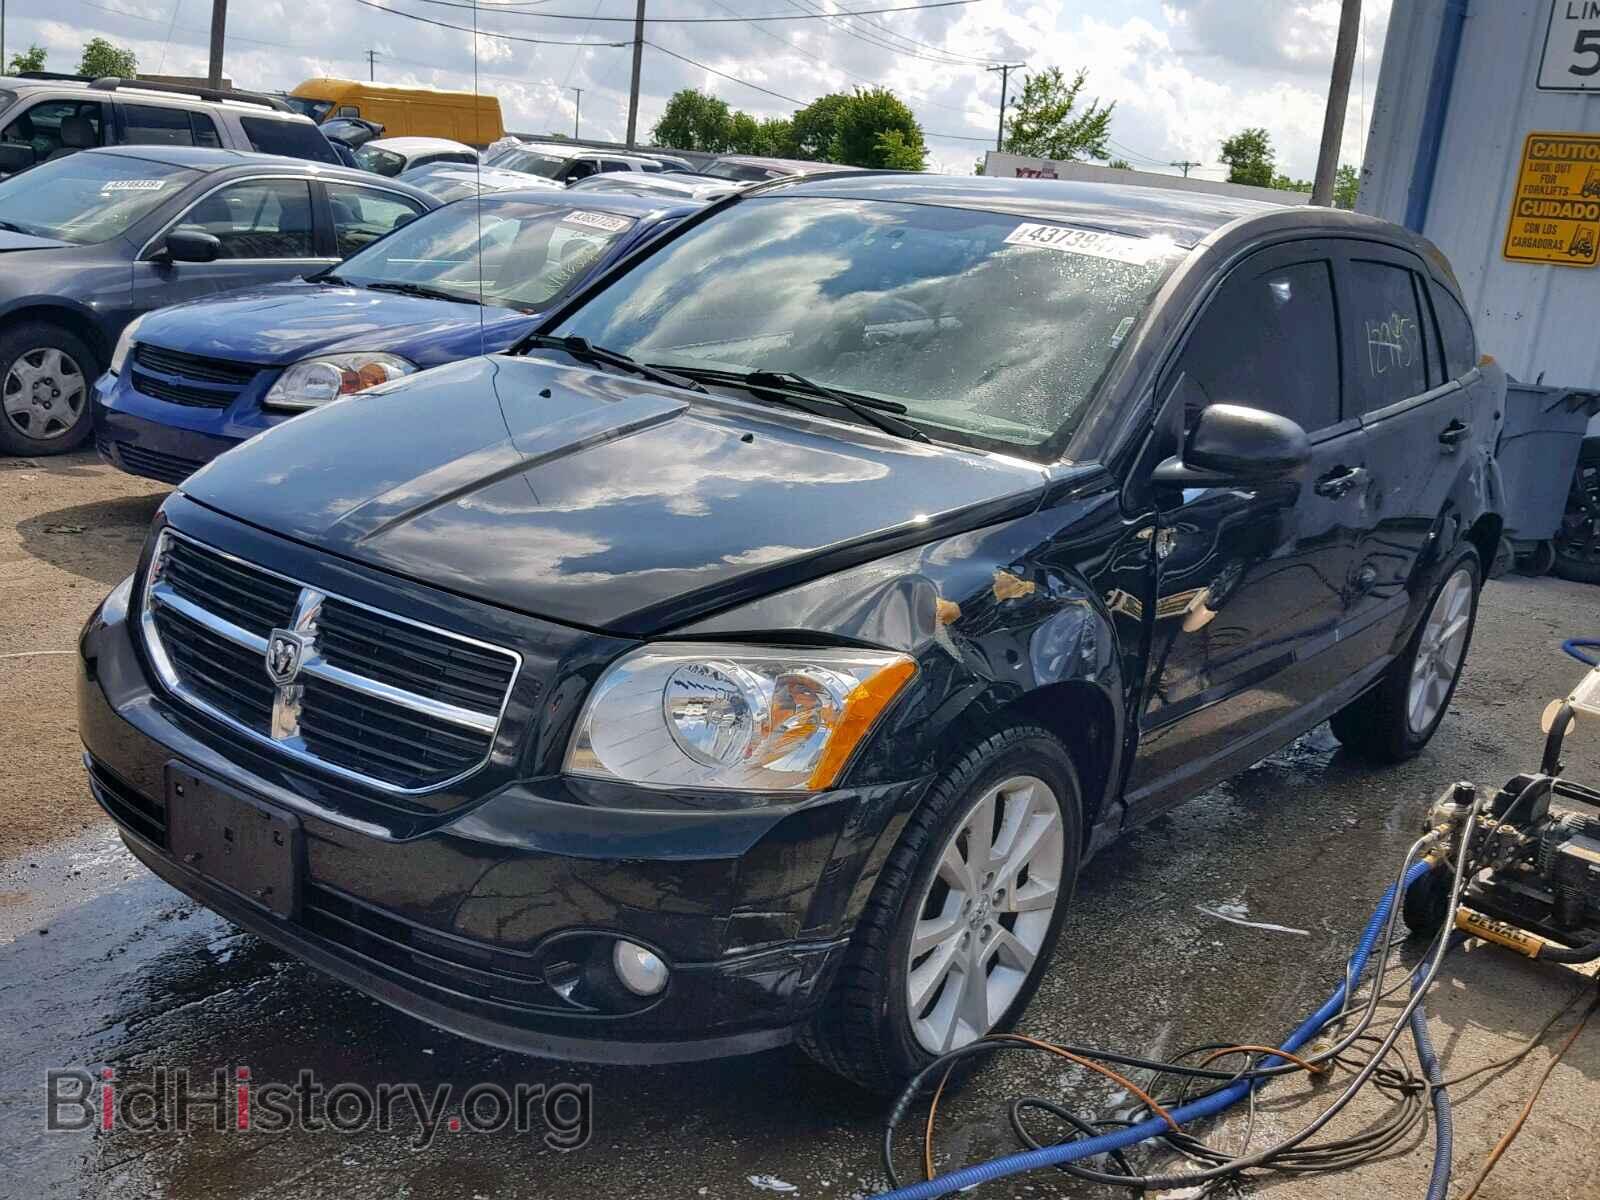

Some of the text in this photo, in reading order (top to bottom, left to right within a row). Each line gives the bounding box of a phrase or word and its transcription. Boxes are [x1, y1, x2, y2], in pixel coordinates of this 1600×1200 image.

[1528, 162, 1571, 174] LOOK OUT
[1540, 174, 1557, 185] FOR
[1523, 184, 1570, 196] FORKLIFTS
[1520, 199, 1599, 220] CUIDADO
[1523, 222, 1558, 235] CON LOS
[1511, 236, 1564, 251] CARGADORAS
[1466, 913, 1530, 944] DEWALT
